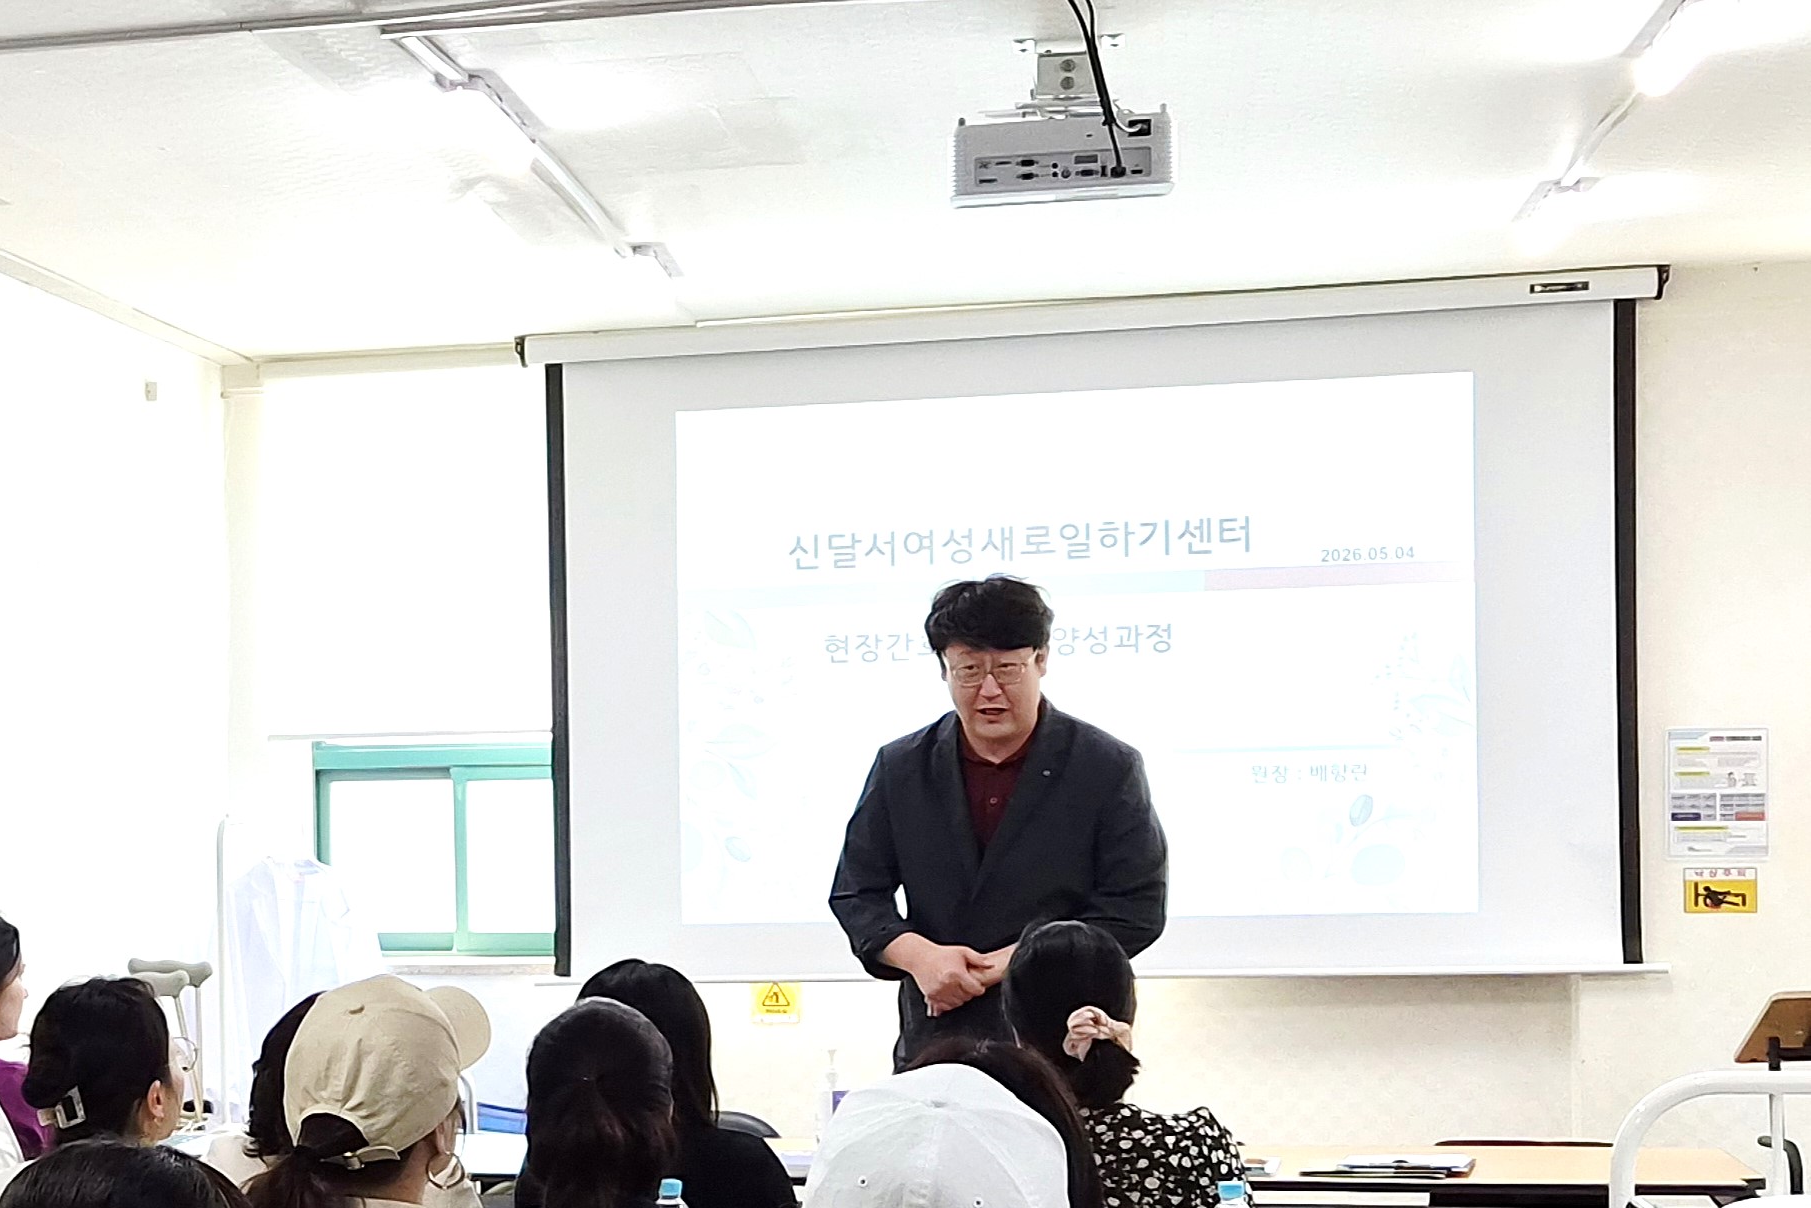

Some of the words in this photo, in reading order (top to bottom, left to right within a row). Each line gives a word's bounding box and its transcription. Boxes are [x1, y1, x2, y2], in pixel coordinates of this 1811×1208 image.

[788, 515, 1252, 571] 신달서여성새로일하기센터
[1320, 546, 1417, 563] 2026.05.04
[1052, 623, 1174, 657] 양성과정
